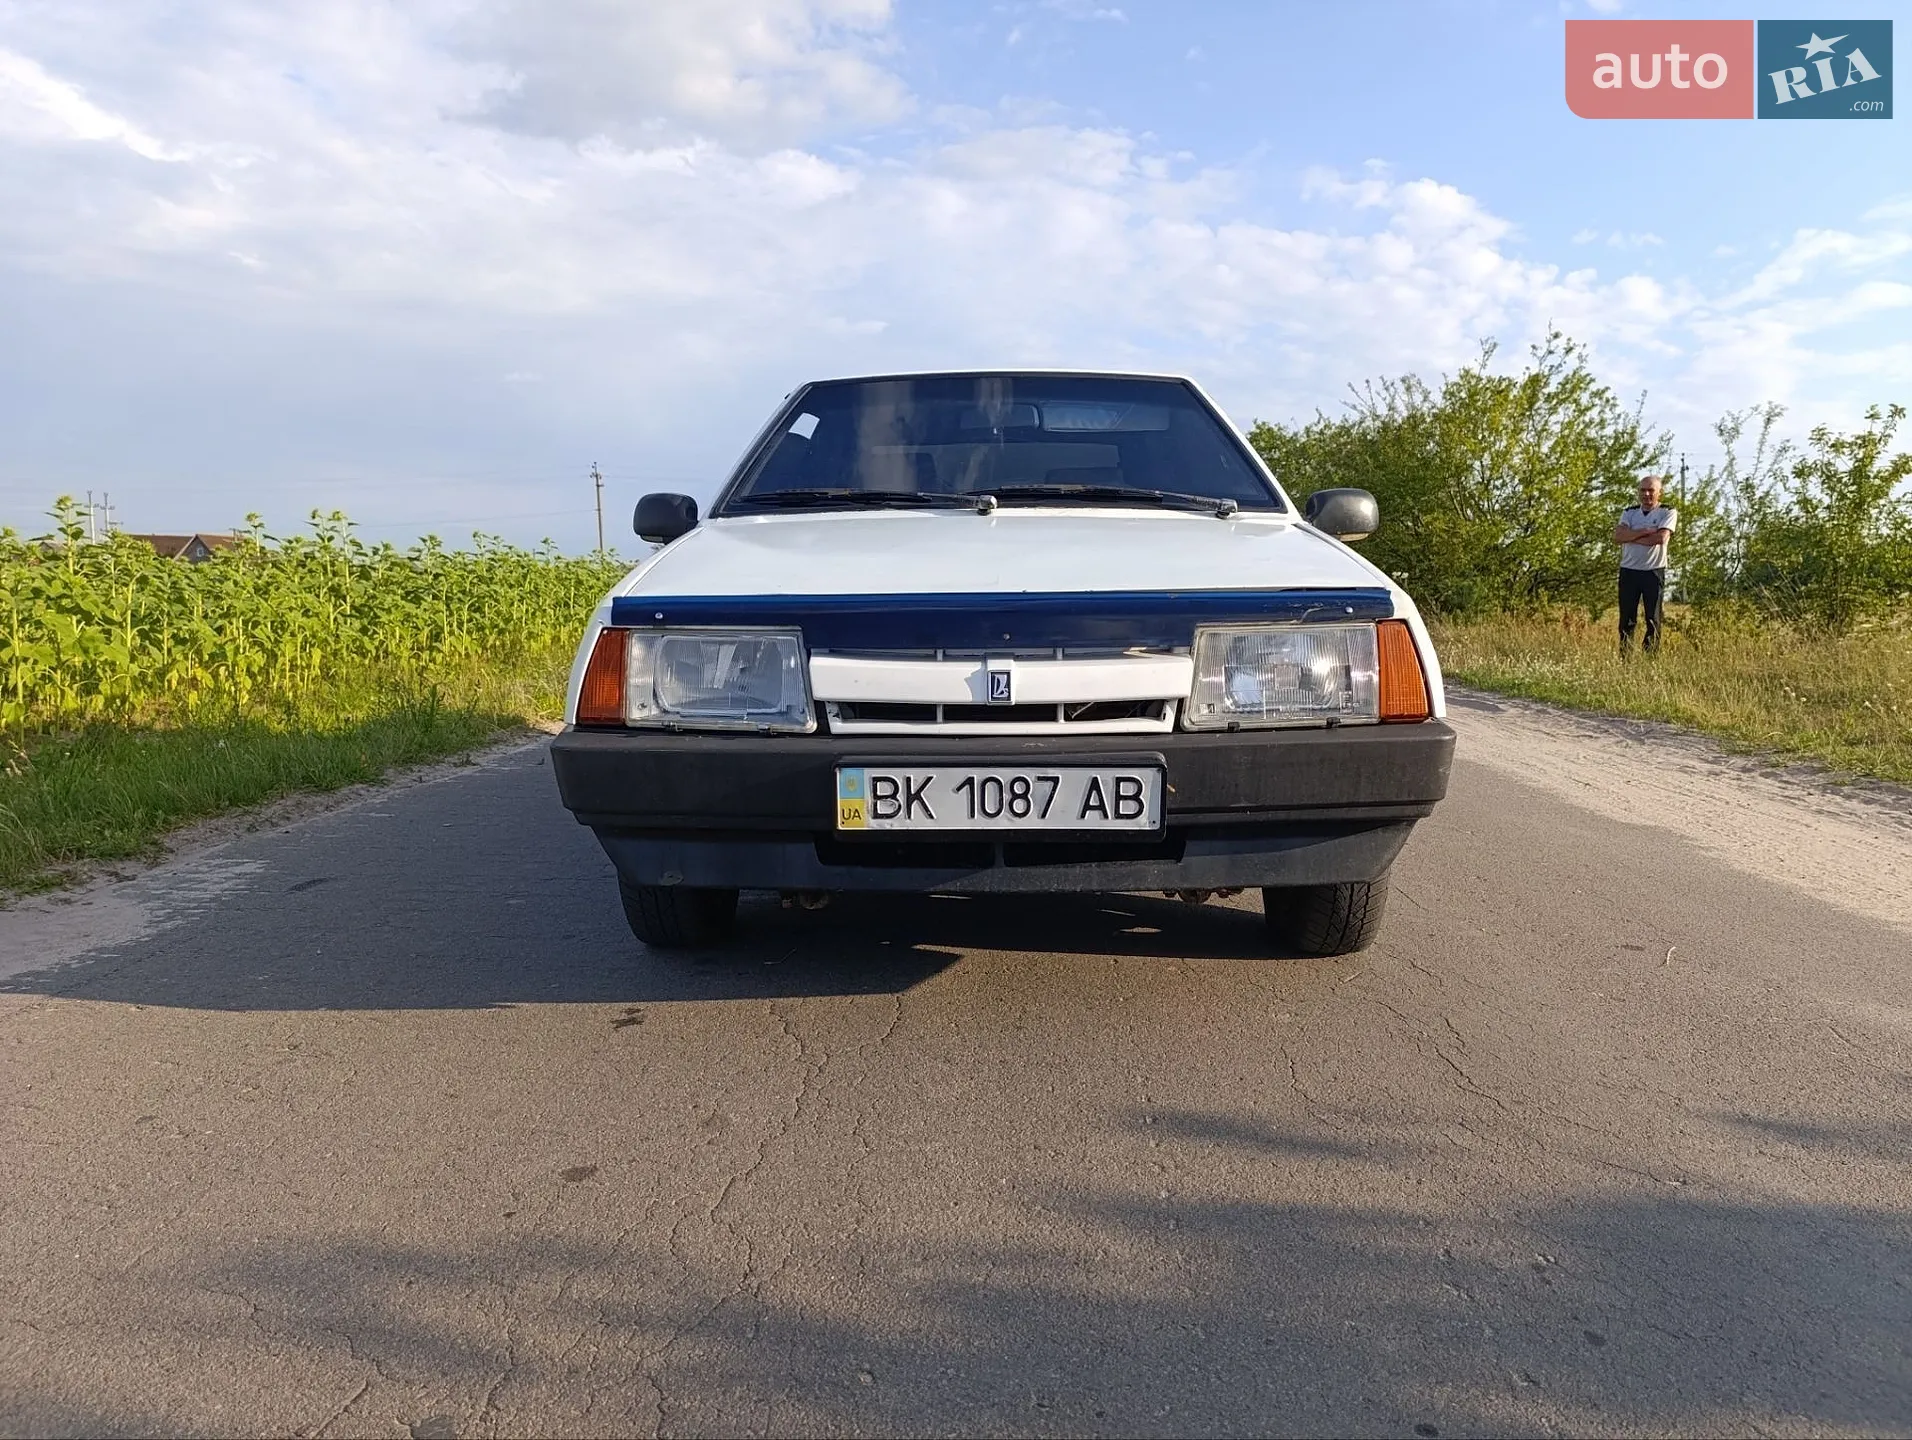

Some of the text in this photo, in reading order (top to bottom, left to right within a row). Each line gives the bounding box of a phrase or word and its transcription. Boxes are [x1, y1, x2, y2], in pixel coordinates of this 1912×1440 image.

[871, 776, 1146, 820] BK 1087 AB
[841, 807, 862, 821] UA
